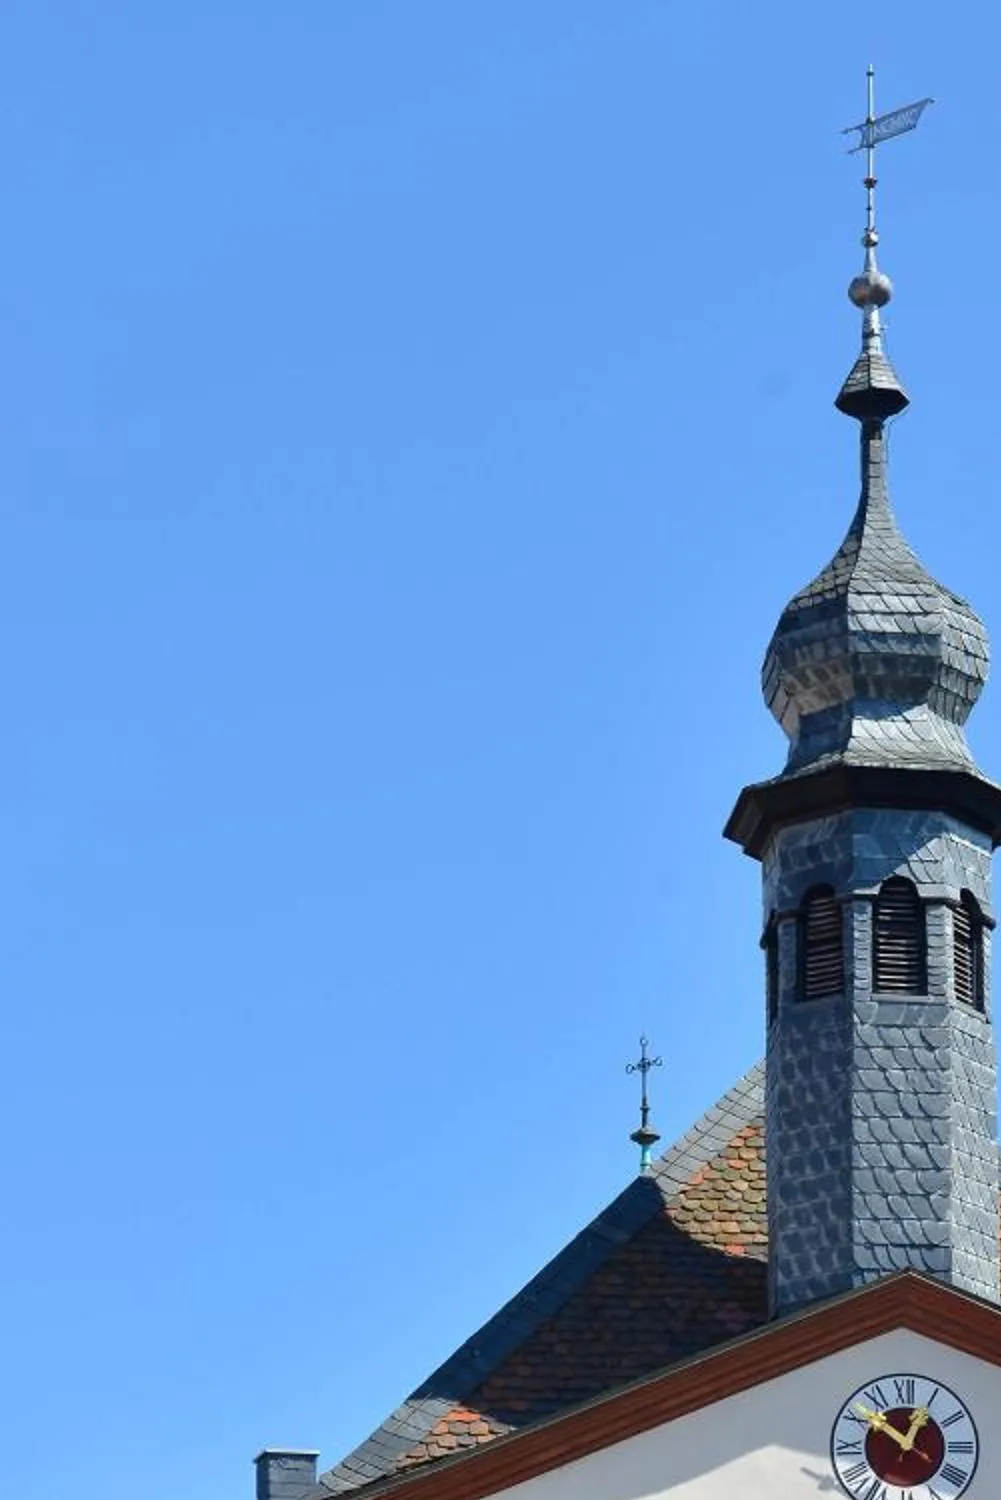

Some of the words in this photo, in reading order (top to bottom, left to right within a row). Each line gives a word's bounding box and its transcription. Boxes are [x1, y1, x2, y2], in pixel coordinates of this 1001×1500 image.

[863, 1384, 889, 1411] XI
[893, 1379, 915, 1405] XII
[927, 1387, 939, 1407] I
[940, 1410, 965, 1428] II
[836, 1439, 862, 1456] IX
[947, 1441, 974, 1454] III
